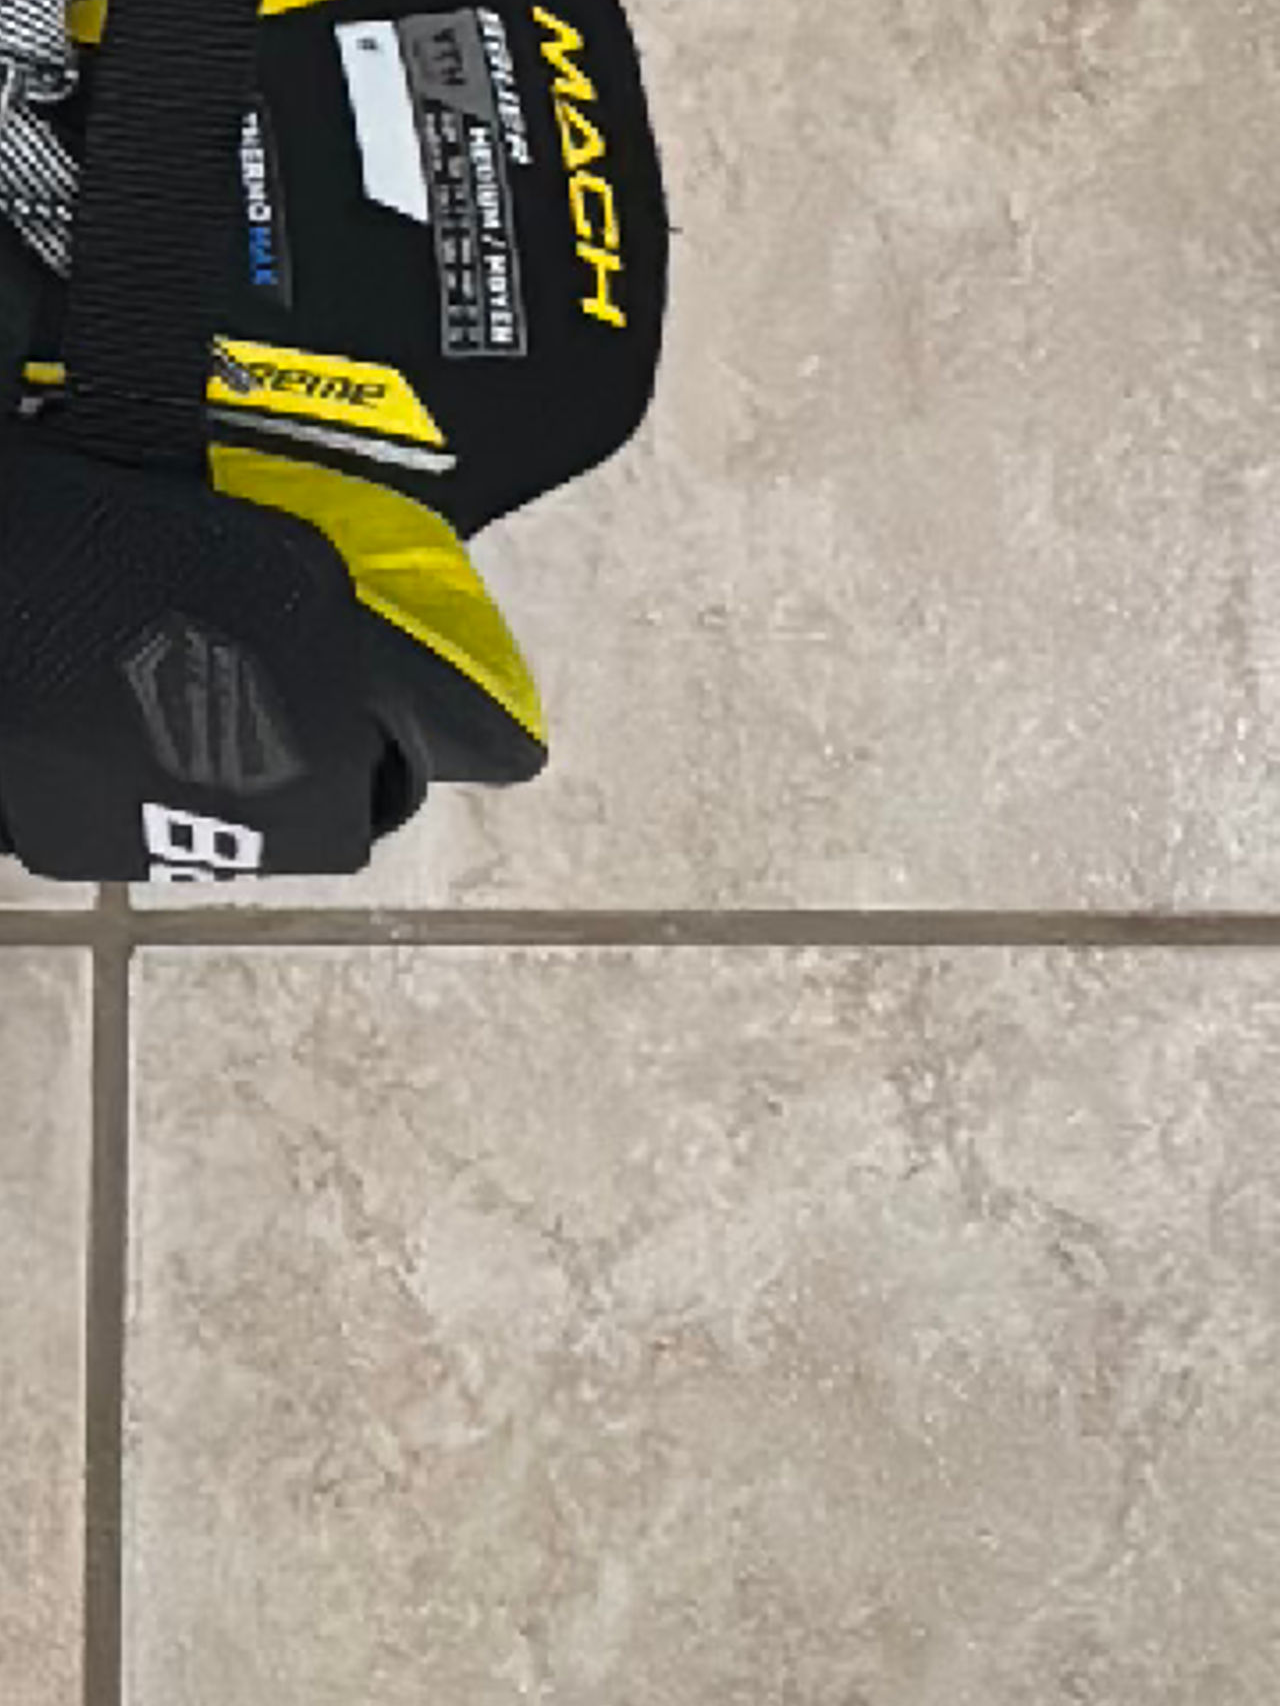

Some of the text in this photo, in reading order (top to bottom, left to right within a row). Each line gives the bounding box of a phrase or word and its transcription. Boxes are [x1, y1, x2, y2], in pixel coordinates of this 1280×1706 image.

[240, 111, 272, 222] THERMO
[469, 125, 502, 230] MEDIUM
[532, 4, 628, 329] MACH
[483, 253, 515, 345] MOYEN
